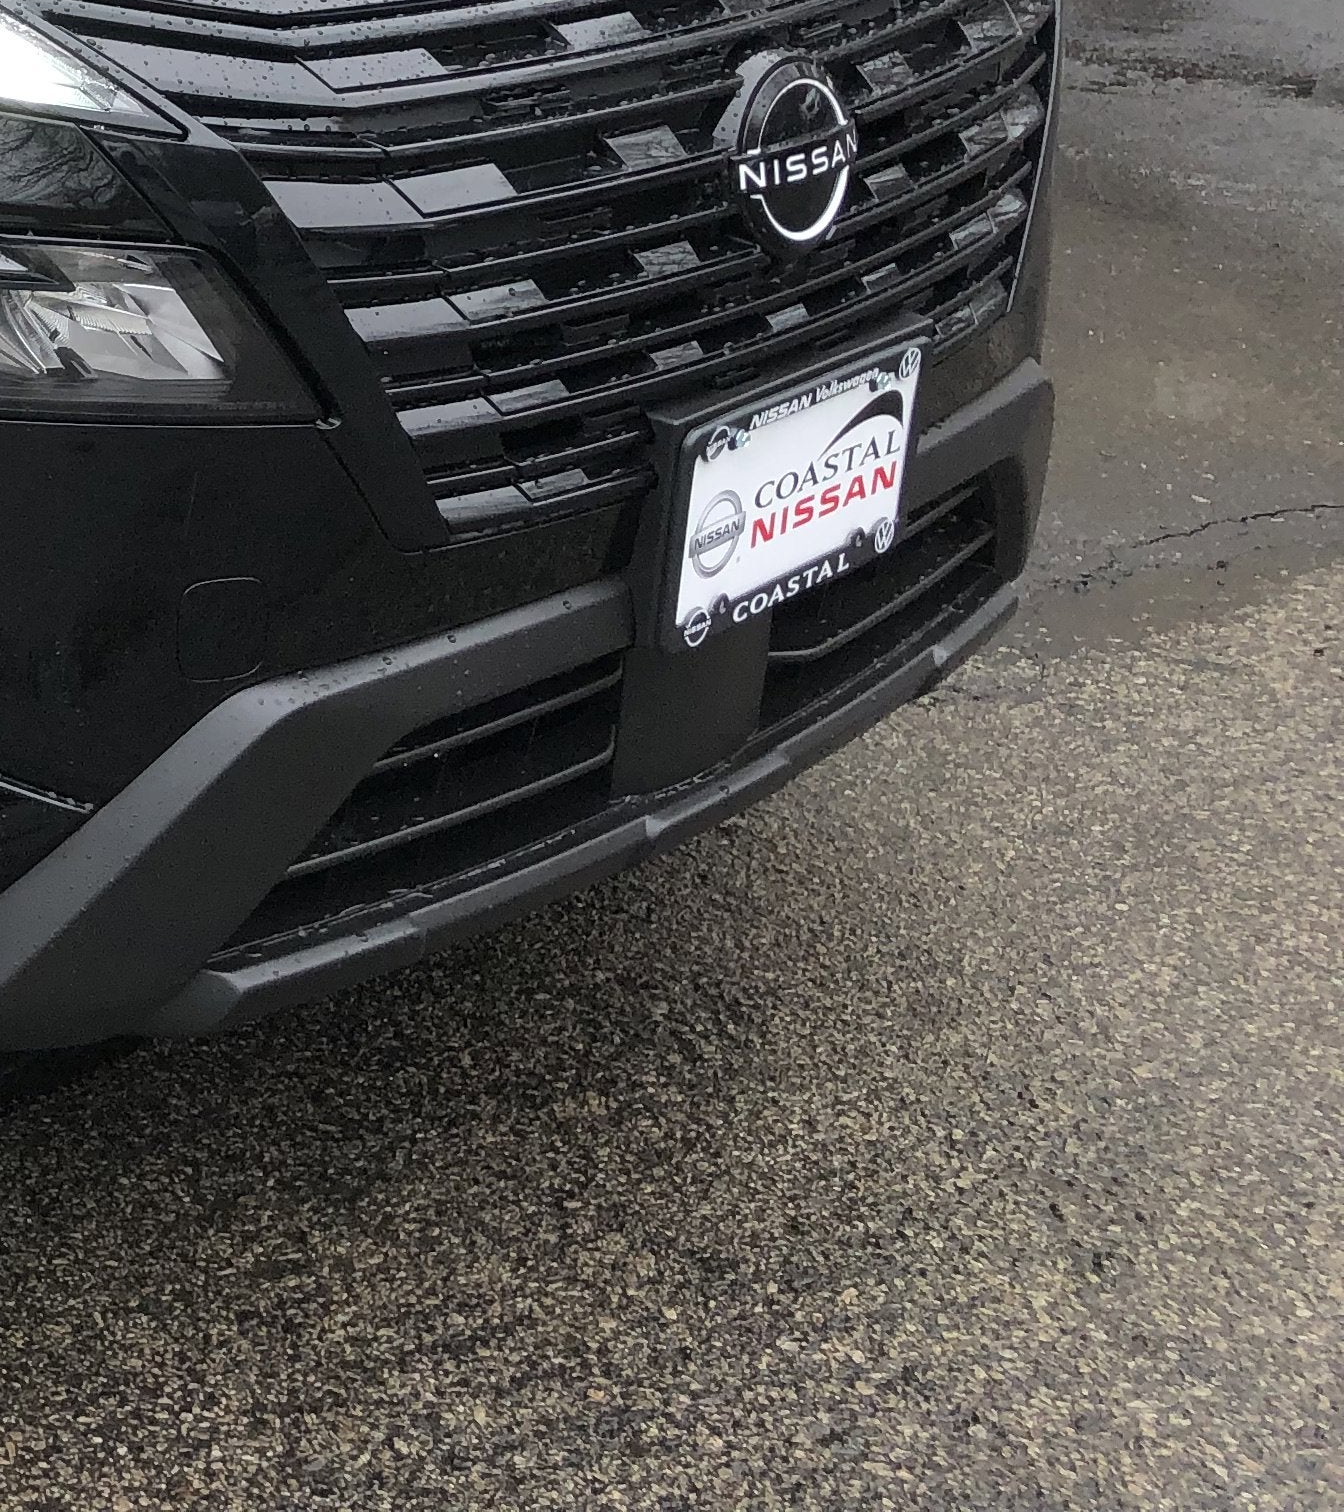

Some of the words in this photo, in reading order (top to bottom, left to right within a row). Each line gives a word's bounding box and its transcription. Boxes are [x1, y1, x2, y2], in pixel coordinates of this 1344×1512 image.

[739, 128, 858, 191] NISSAN
[749, 394, 812, 432] NISSAN
[816, 367, 879, 403] Volkswagen
[754, 430, 901, 509] COASTAL
[693, 519, 740, 549] NISSAN
[750, 460, 898, 549] NISSAN
[732, 552, 850, 623] COASTAL
